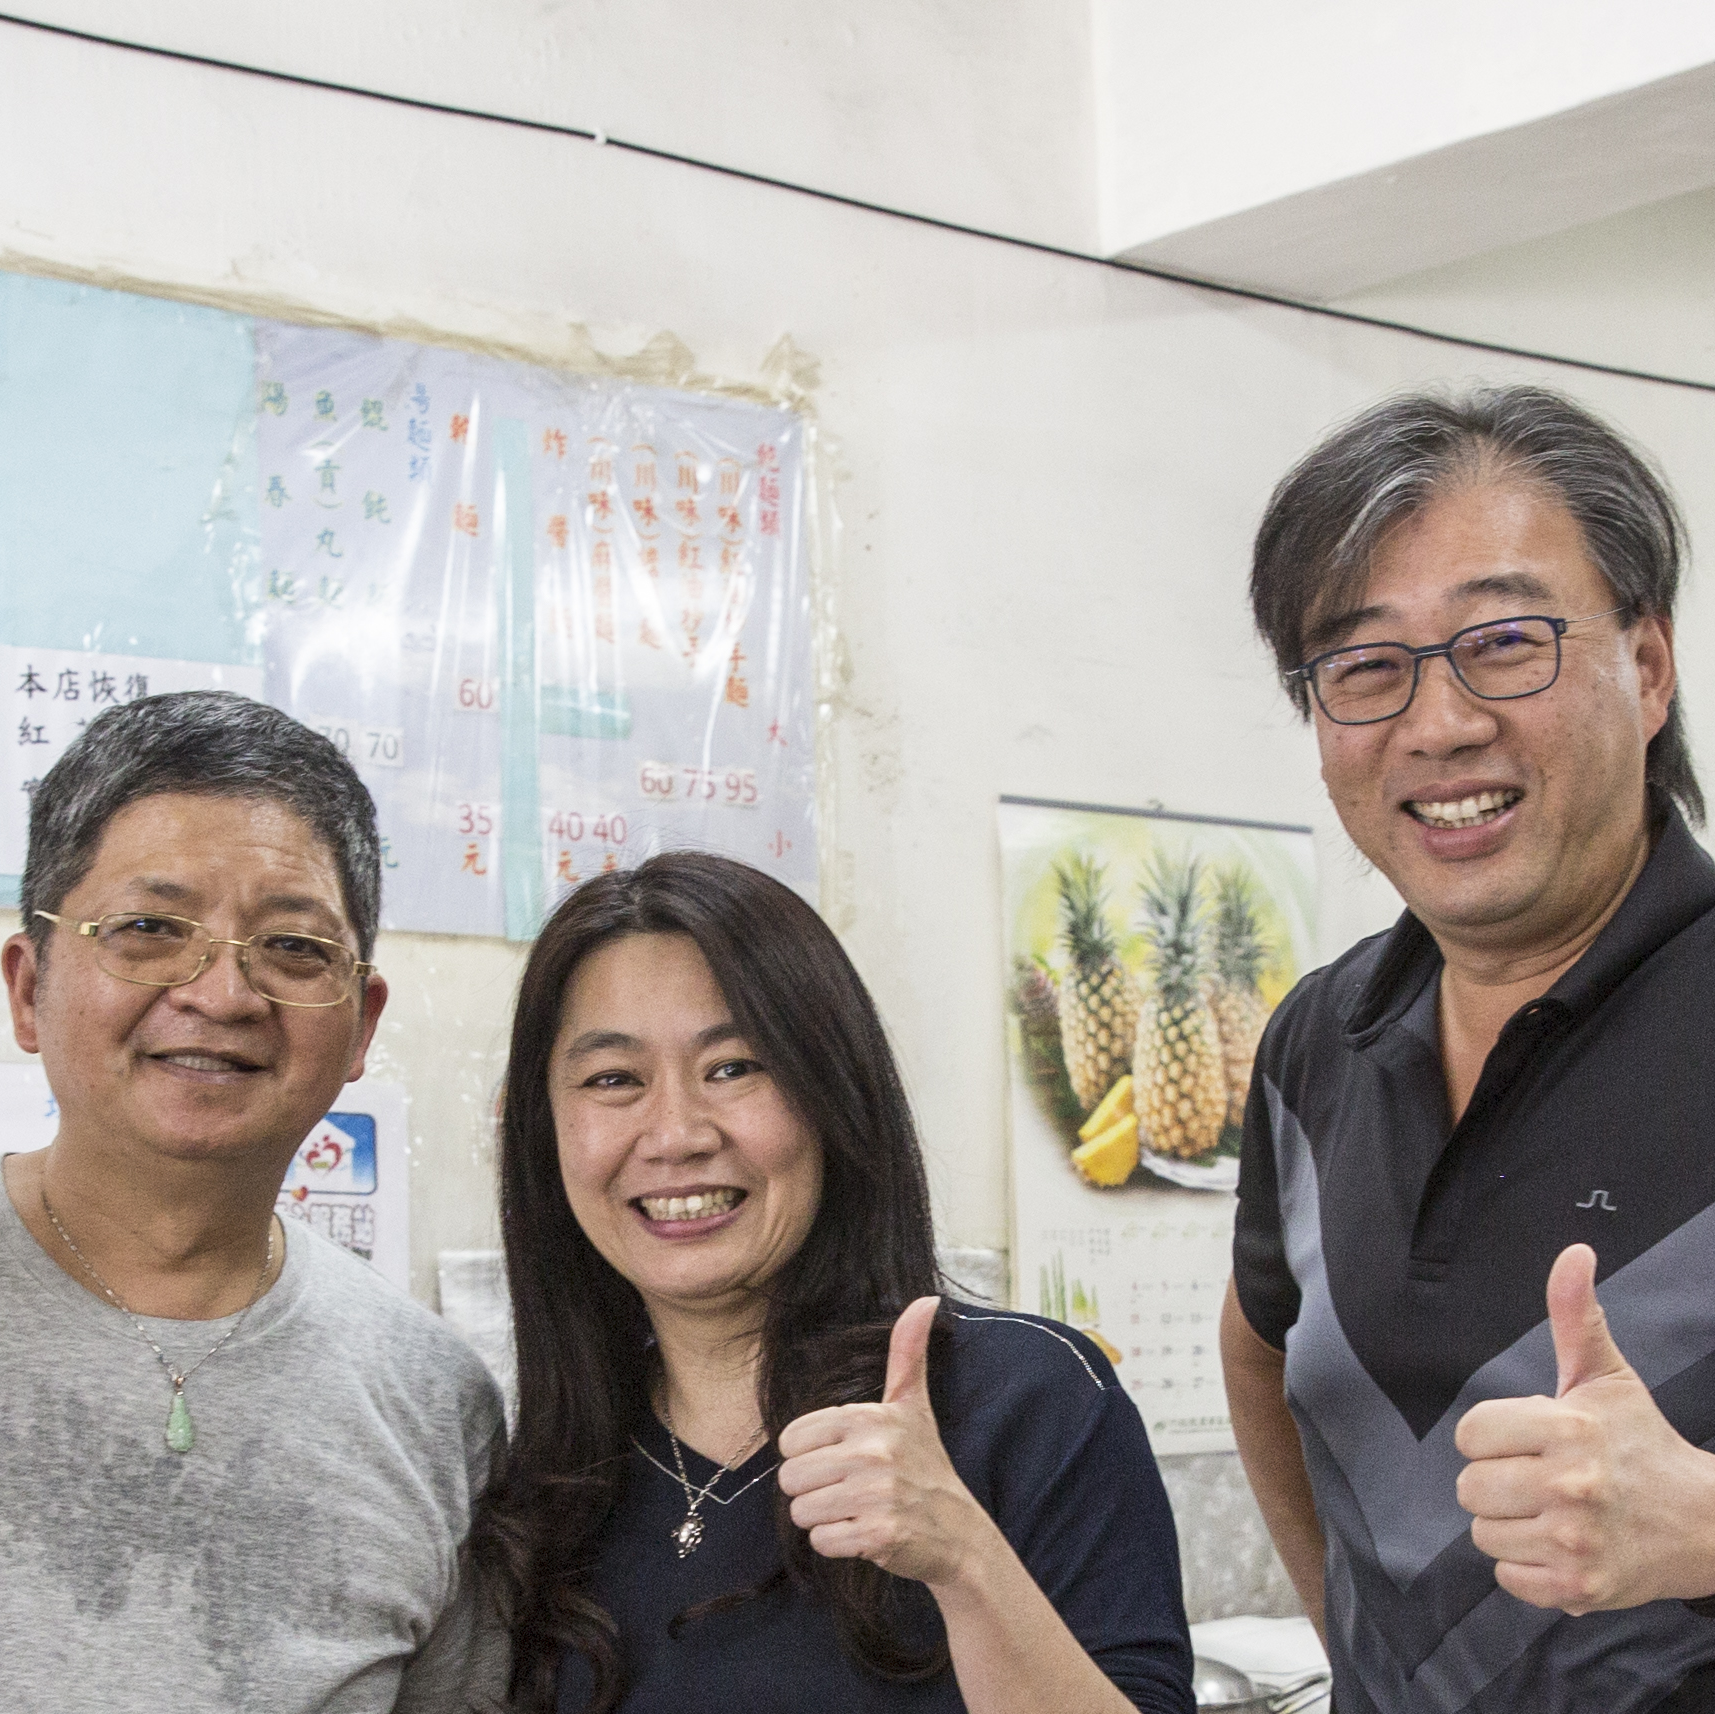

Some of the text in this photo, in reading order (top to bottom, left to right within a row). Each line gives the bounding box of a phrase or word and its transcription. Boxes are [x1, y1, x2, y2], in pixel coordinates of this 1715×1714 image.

[459, 678, 494, 710] 60
[366, 731, 400, 761] 70
[767, 718, 789, 748] 大
[724, 773, 759, 804] 95
[459, 804, 493, 837] 35
[549, 812, 585, 843] 40
[593, 814, 628, 846] 40
[461, 842, 488, 877] 元
[767, 829, 794, 860] 小
[557, 850, 581, 884] 元
